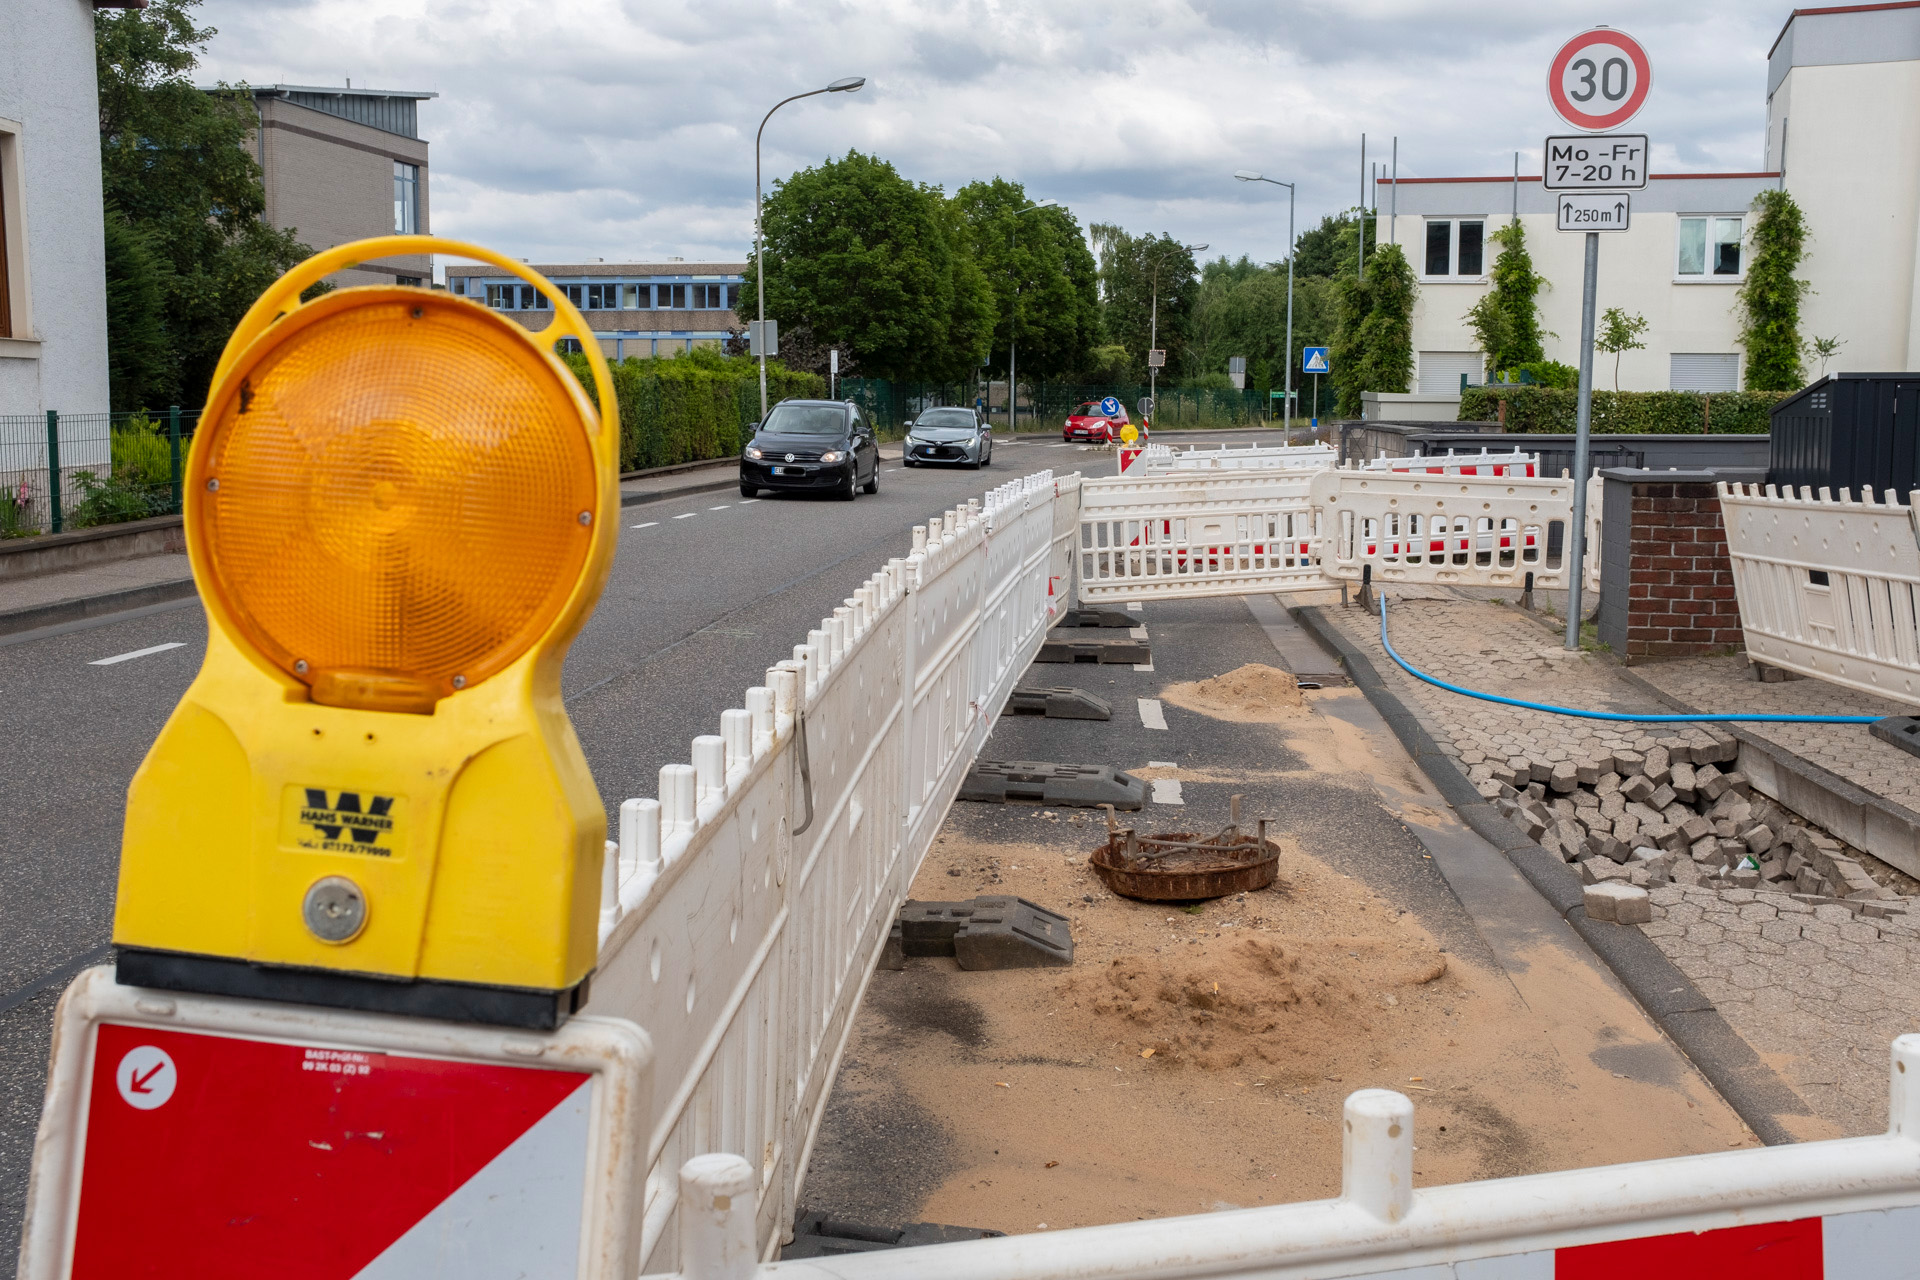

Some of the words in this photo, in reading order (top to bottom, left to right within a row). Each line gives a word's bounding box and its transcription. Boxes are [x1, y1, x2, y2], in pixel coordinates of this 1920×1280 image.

[1570, 57, 1628, 102] 30
[1552, 145, 1589, 162] Mo
[1556, 164, 1612, 182] 7-20
[1622, 164, 1636, 181] h
